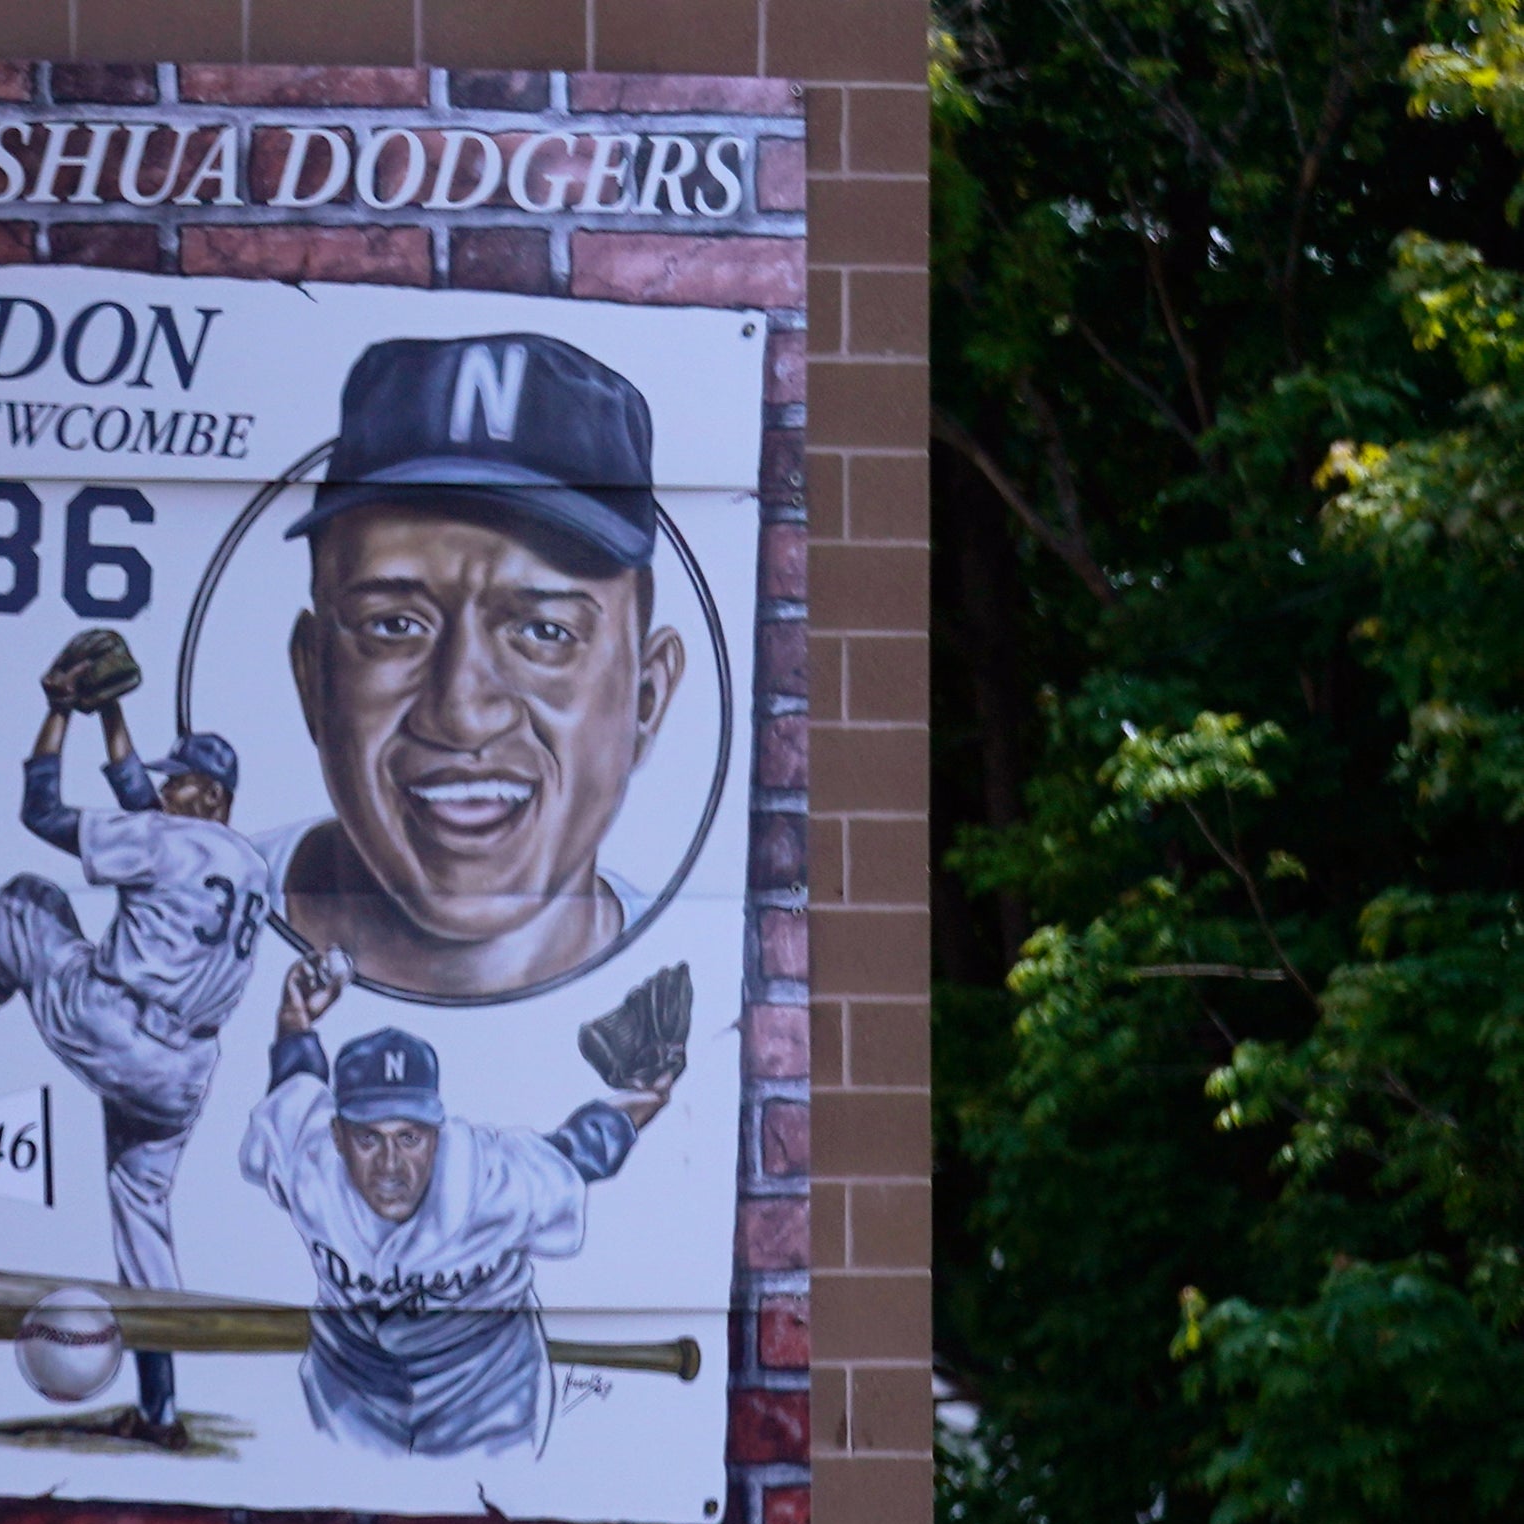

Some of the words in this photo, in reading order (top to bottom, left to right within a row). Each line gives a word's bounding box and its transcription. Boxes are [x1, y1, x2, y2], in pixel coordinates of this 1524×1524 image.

[267, 127, 748, 218] DODGERS
[448, 341, 528, 443] N
[384, 1051, 406, 1083] N
[313, 1240, 528, 1316] Dodgers
